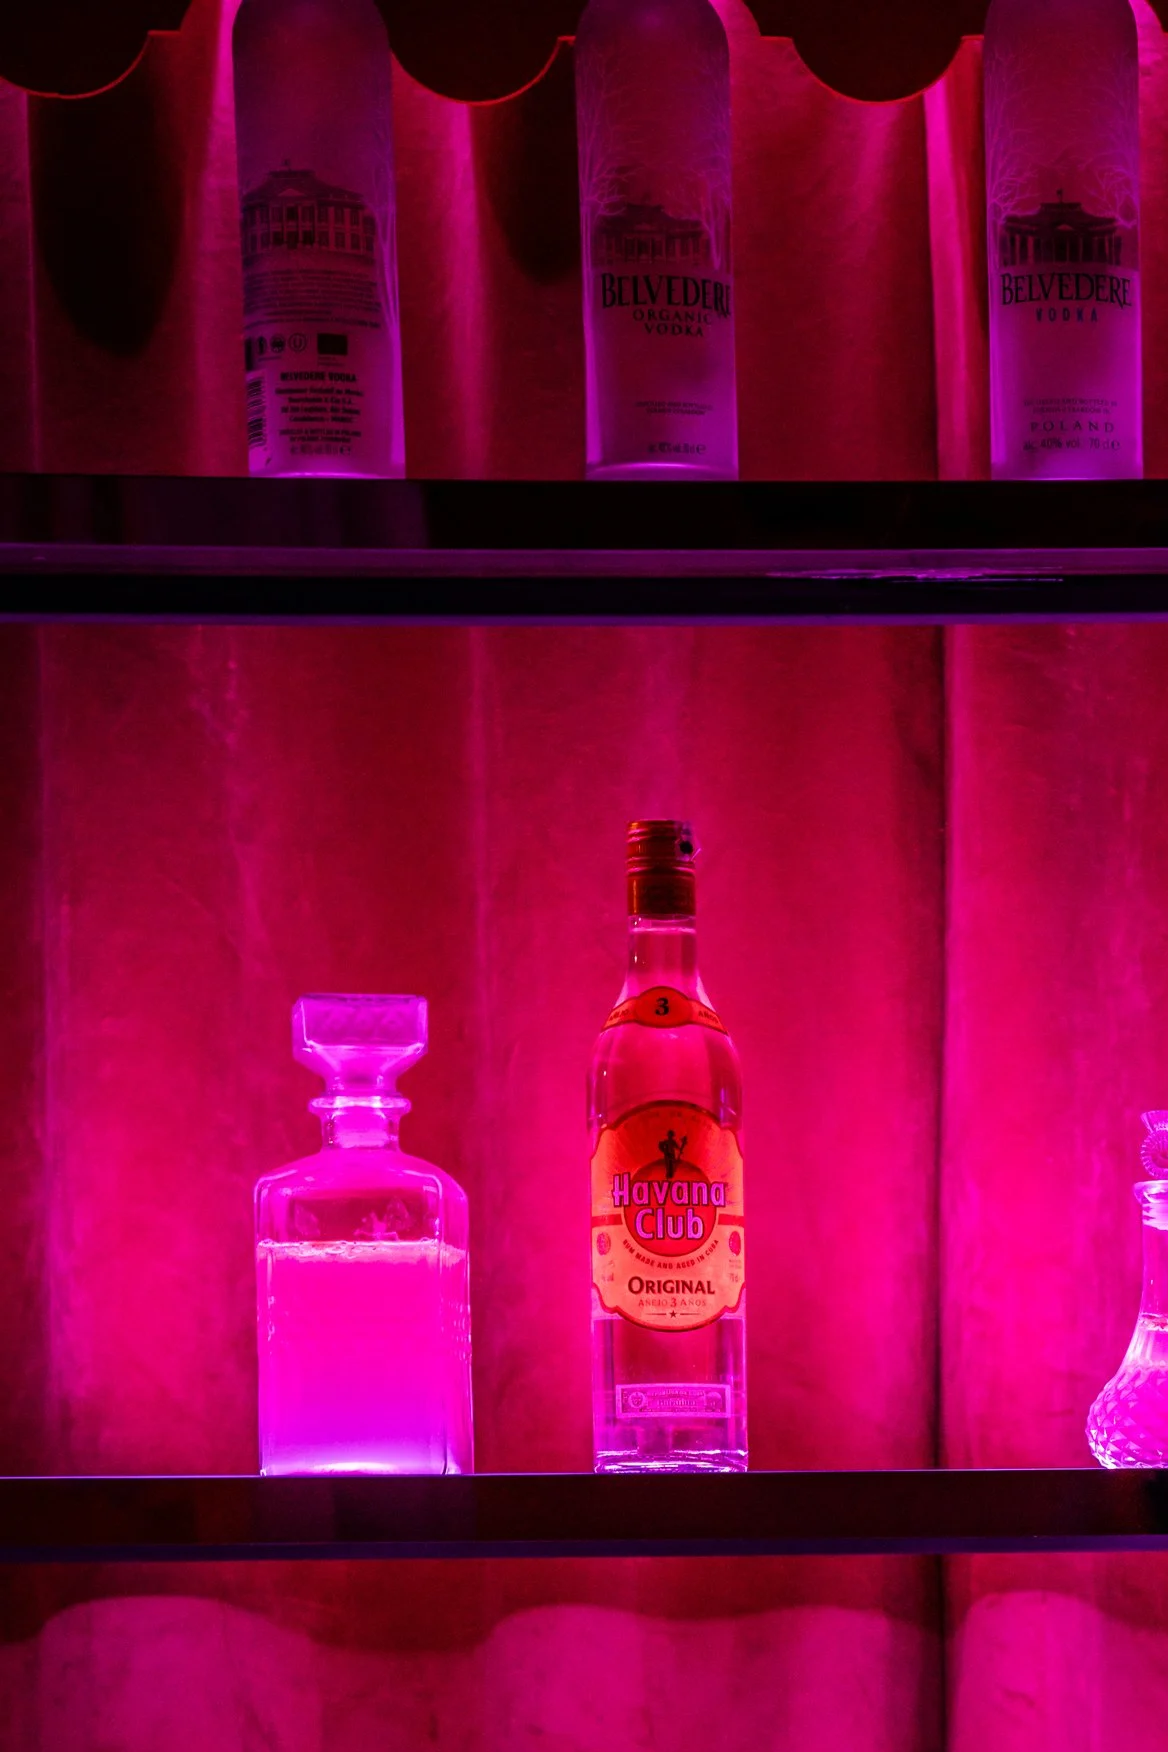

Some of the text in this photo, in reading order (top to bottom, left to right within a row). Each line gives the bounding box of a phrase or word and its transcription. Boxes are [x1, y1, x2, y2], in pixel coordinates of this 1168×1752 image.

[1002, 273, 1132, 308] BELVEDERE
[633, 309, 713, 325] ORGANIC
[1036, 308, 1098, 322] VODKA
[645, 322, 704, 337] VODKA
[1030, 420, 1114, 433] POLAND
[654, 997, 670, 1017] 3
[612, 1172, 727, 1208] Havana
[634, 1207, 705, 1240] Club
[635, 1251, 655, 1268] MADE
[657, 1261, 674, 1270] AND
[676, 1259, 695, 1270] AGED
[696, 1254, 705, 1265] IN
[704, 1239, 720, 1257] CUBA
[628, 1276, 715, 1295] ORIGINAL
[670, 1297, 678, 1307] 3
